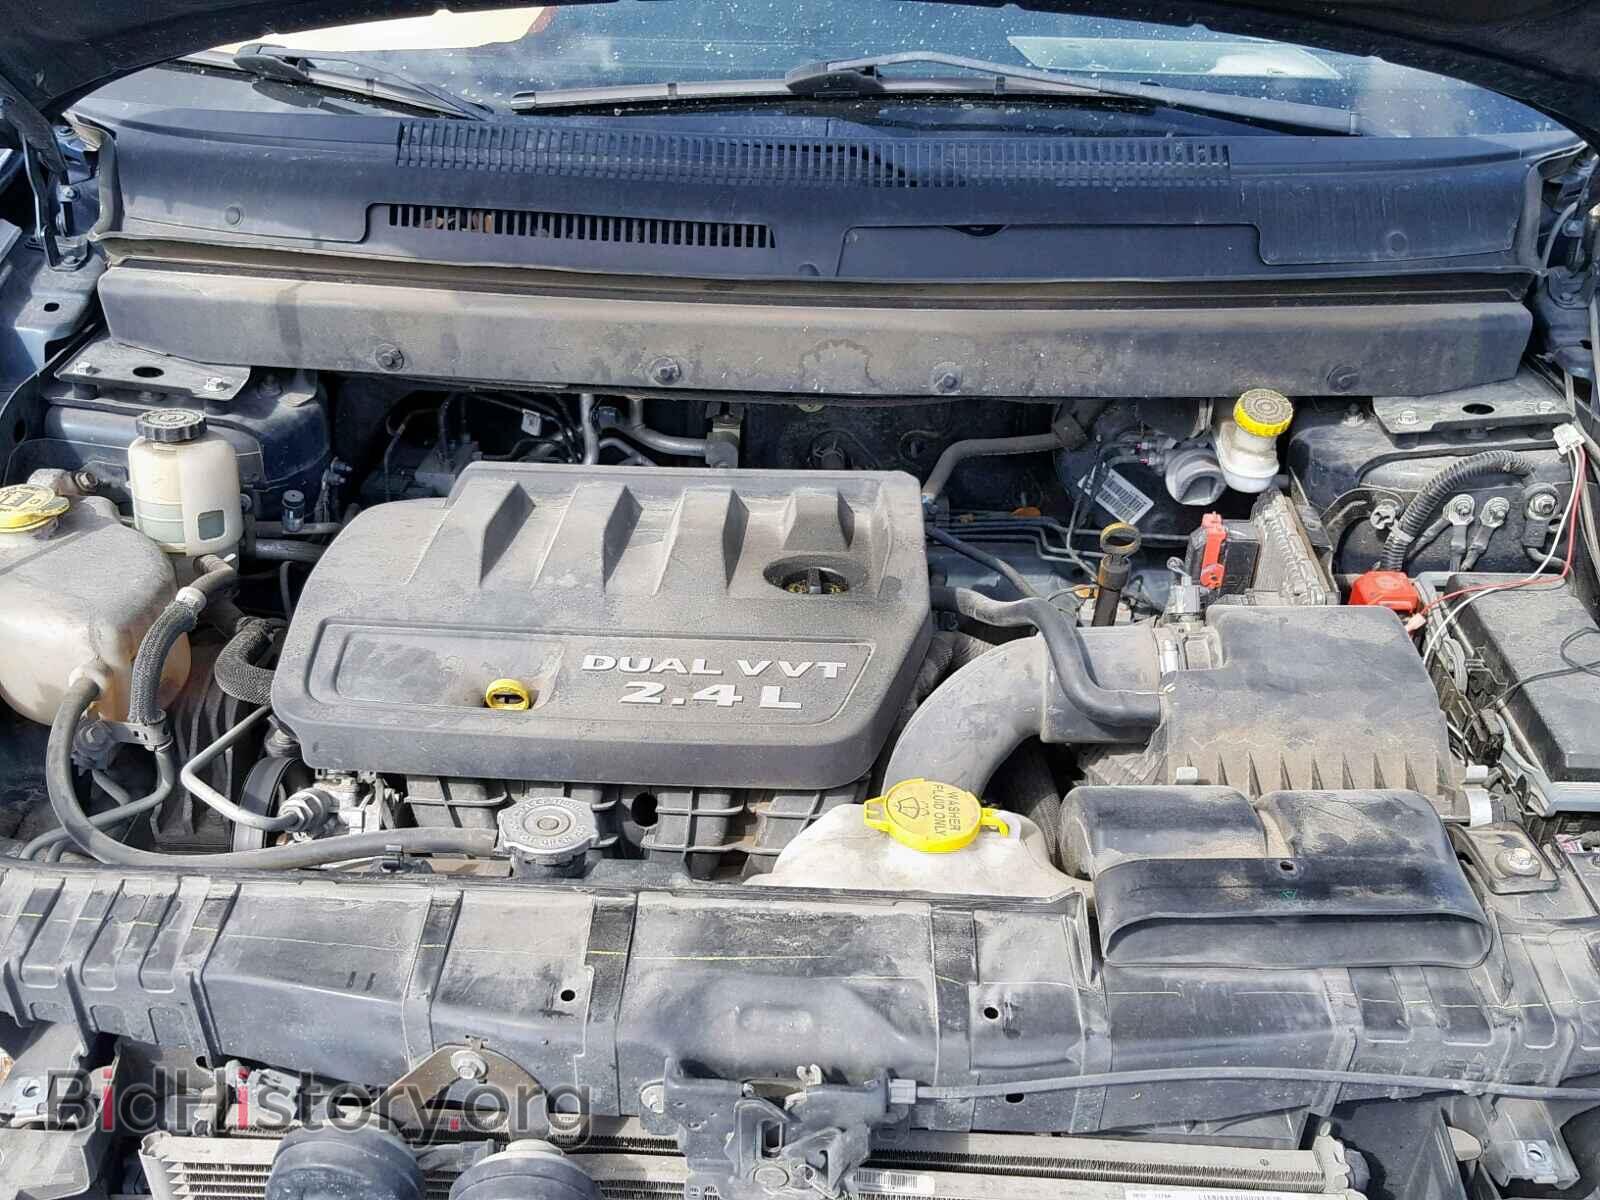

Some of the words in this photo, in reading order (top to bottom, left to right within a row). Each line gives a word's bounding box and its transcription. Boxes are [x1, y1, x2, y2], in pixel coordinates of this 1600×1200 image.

[582, 654, 724, 676] DUAL
[736, 659, 847, 679] VVT
[932, 784, 945, 810] FLUID
[934, 811, 947, 836] ONLY
[948, 791, 961, 831] WASHER
